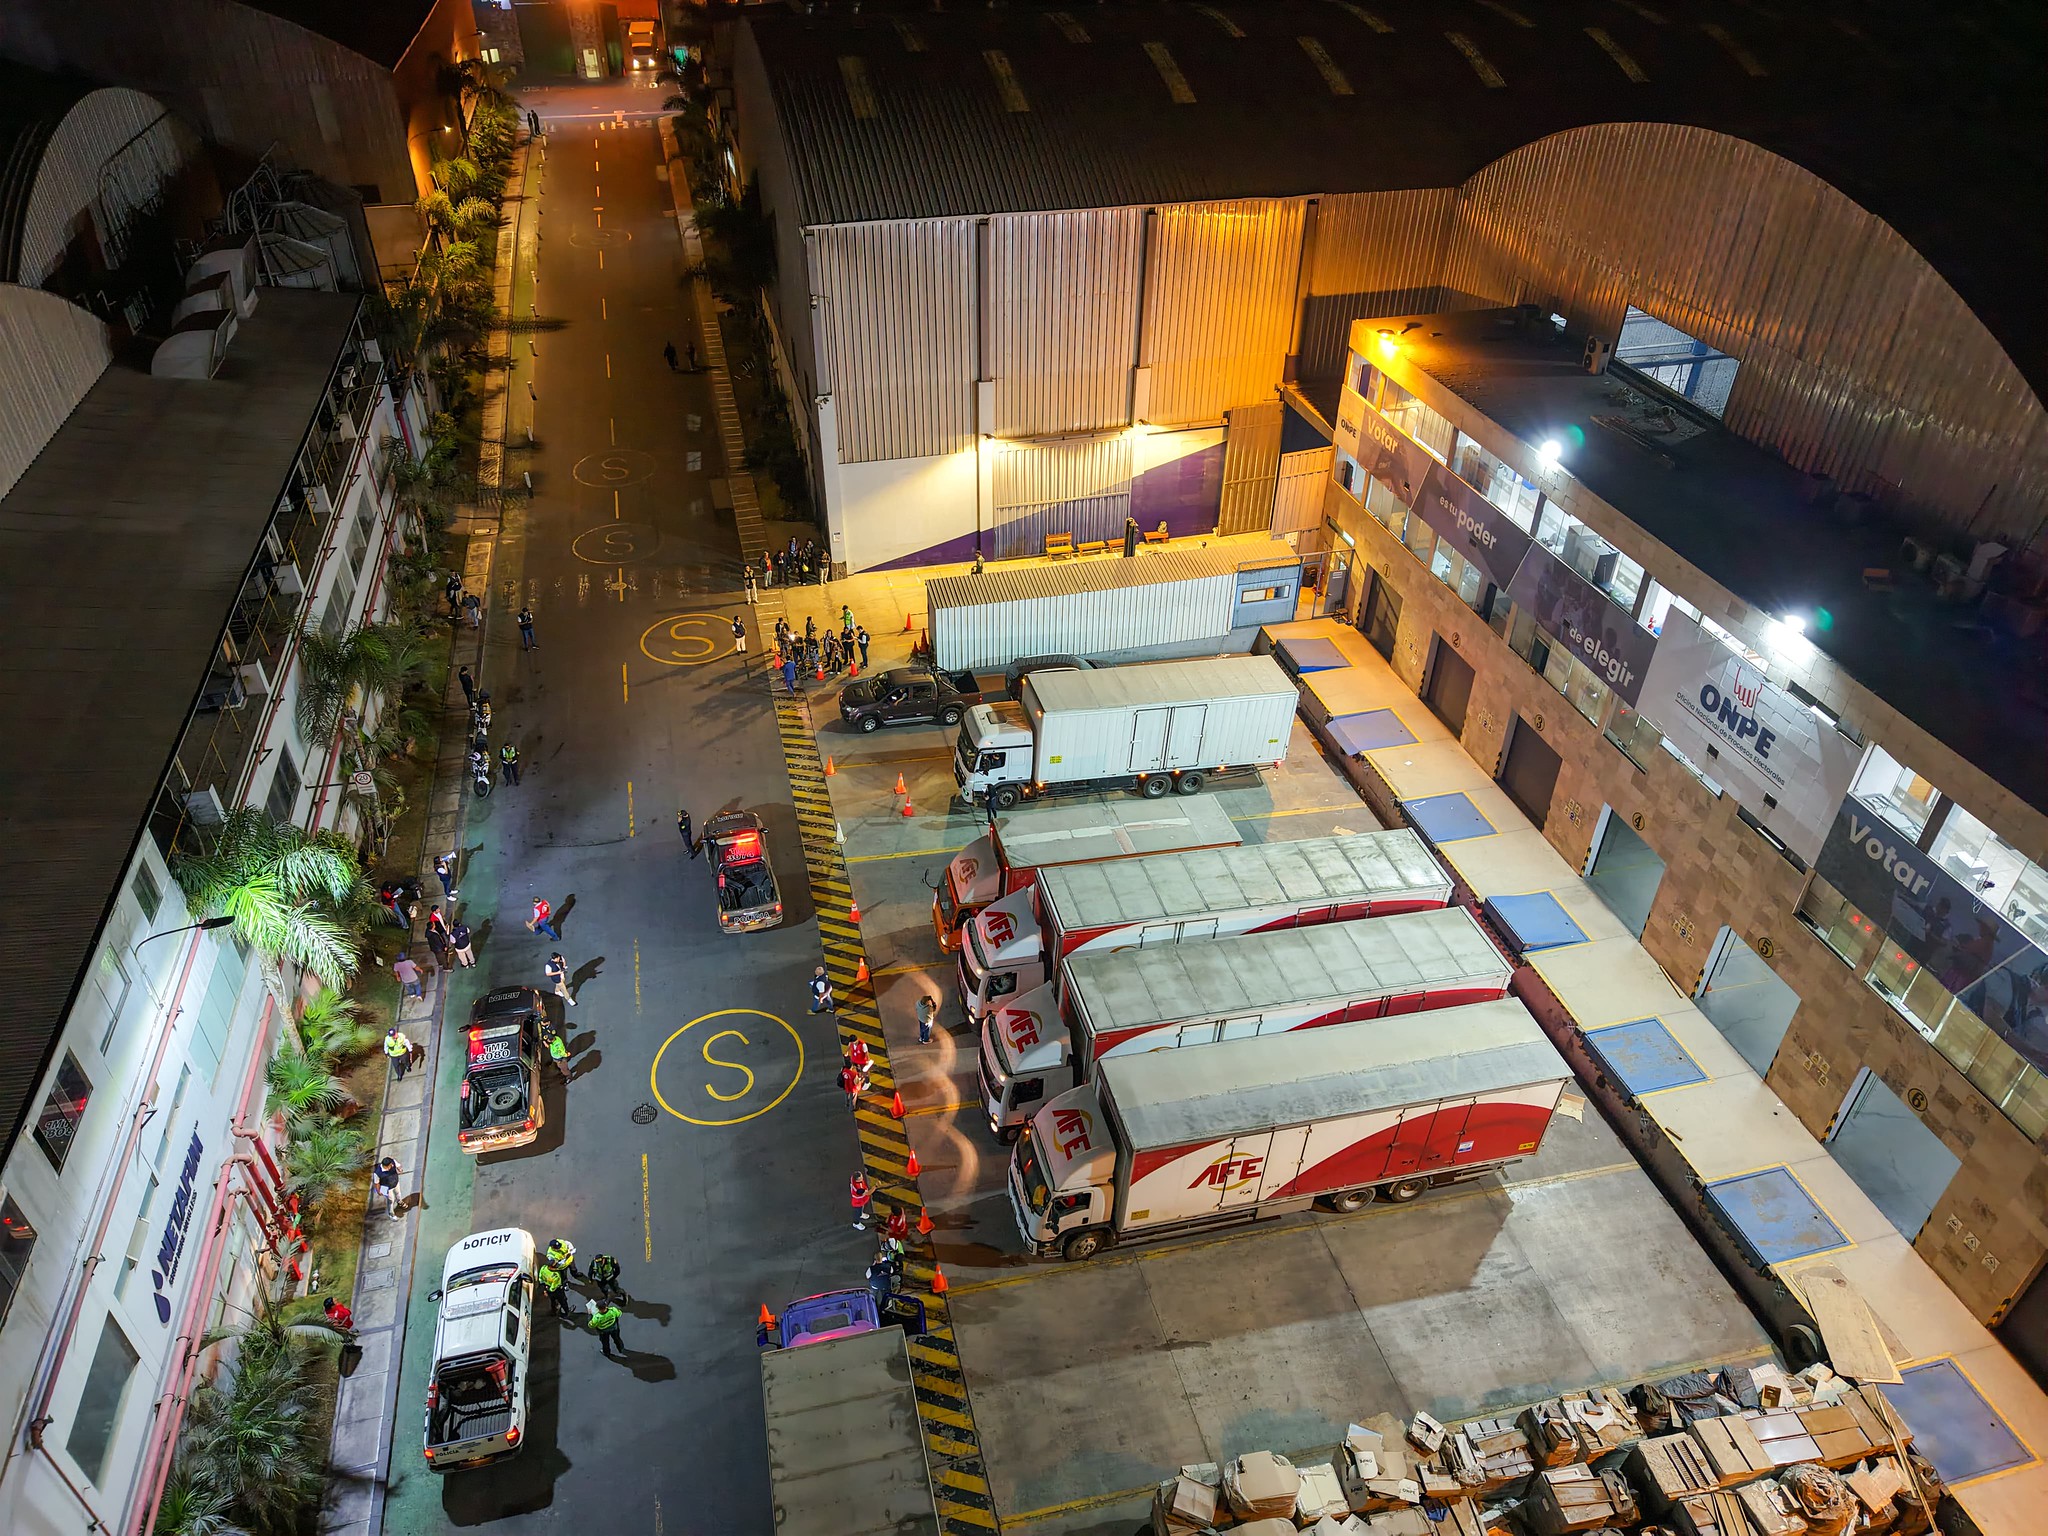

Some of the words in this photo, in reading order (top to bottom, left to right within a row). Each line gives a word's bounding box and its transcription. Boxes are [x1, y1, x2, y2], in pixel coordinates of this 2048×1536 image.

[1341, 419, 1357, 438] ONPE
[1368, 415, 1398, 453] Votar
[1440, 496, 1448, 509] es
[1449, 501, 1458, 516] tu
[1457, 510, 1497, 550] poder
[670, 620, 715, 658] S
[1570, 628, 1582, 643] de
[1584, 637, 1634, 687] elegir
[1676, 692, 1696, 711] Oficina
[1695, 708, 1720, 732] Nacional
[1719, 725, 1728, 737] de
[1727, 734, 1754, 759] Procesos
[1753, 756, 1785, 786] Electorales
[1700, 684, 1776, 759] ONPE
[960, 858, 977, 884] AFE
[1849, 813, 1930, 895] Votar
[984, 911, 1015, 949] AFE
[1761, 941, 1771, 955] 5
[484, 1041, 508, 1054] TMP
[1006, 1009, 1040, 1054] AFE
[477, 1049, 511, 1063] 3080
[702, 1030, 755, 1101] S
[1912, 1092, 1924, 1108] 6
[1052, 1109, 1092, 1161] AFE
[1187, 1156, 1264, 1190] AFE
[157, 1131, 204, 1278] NETAFIM
